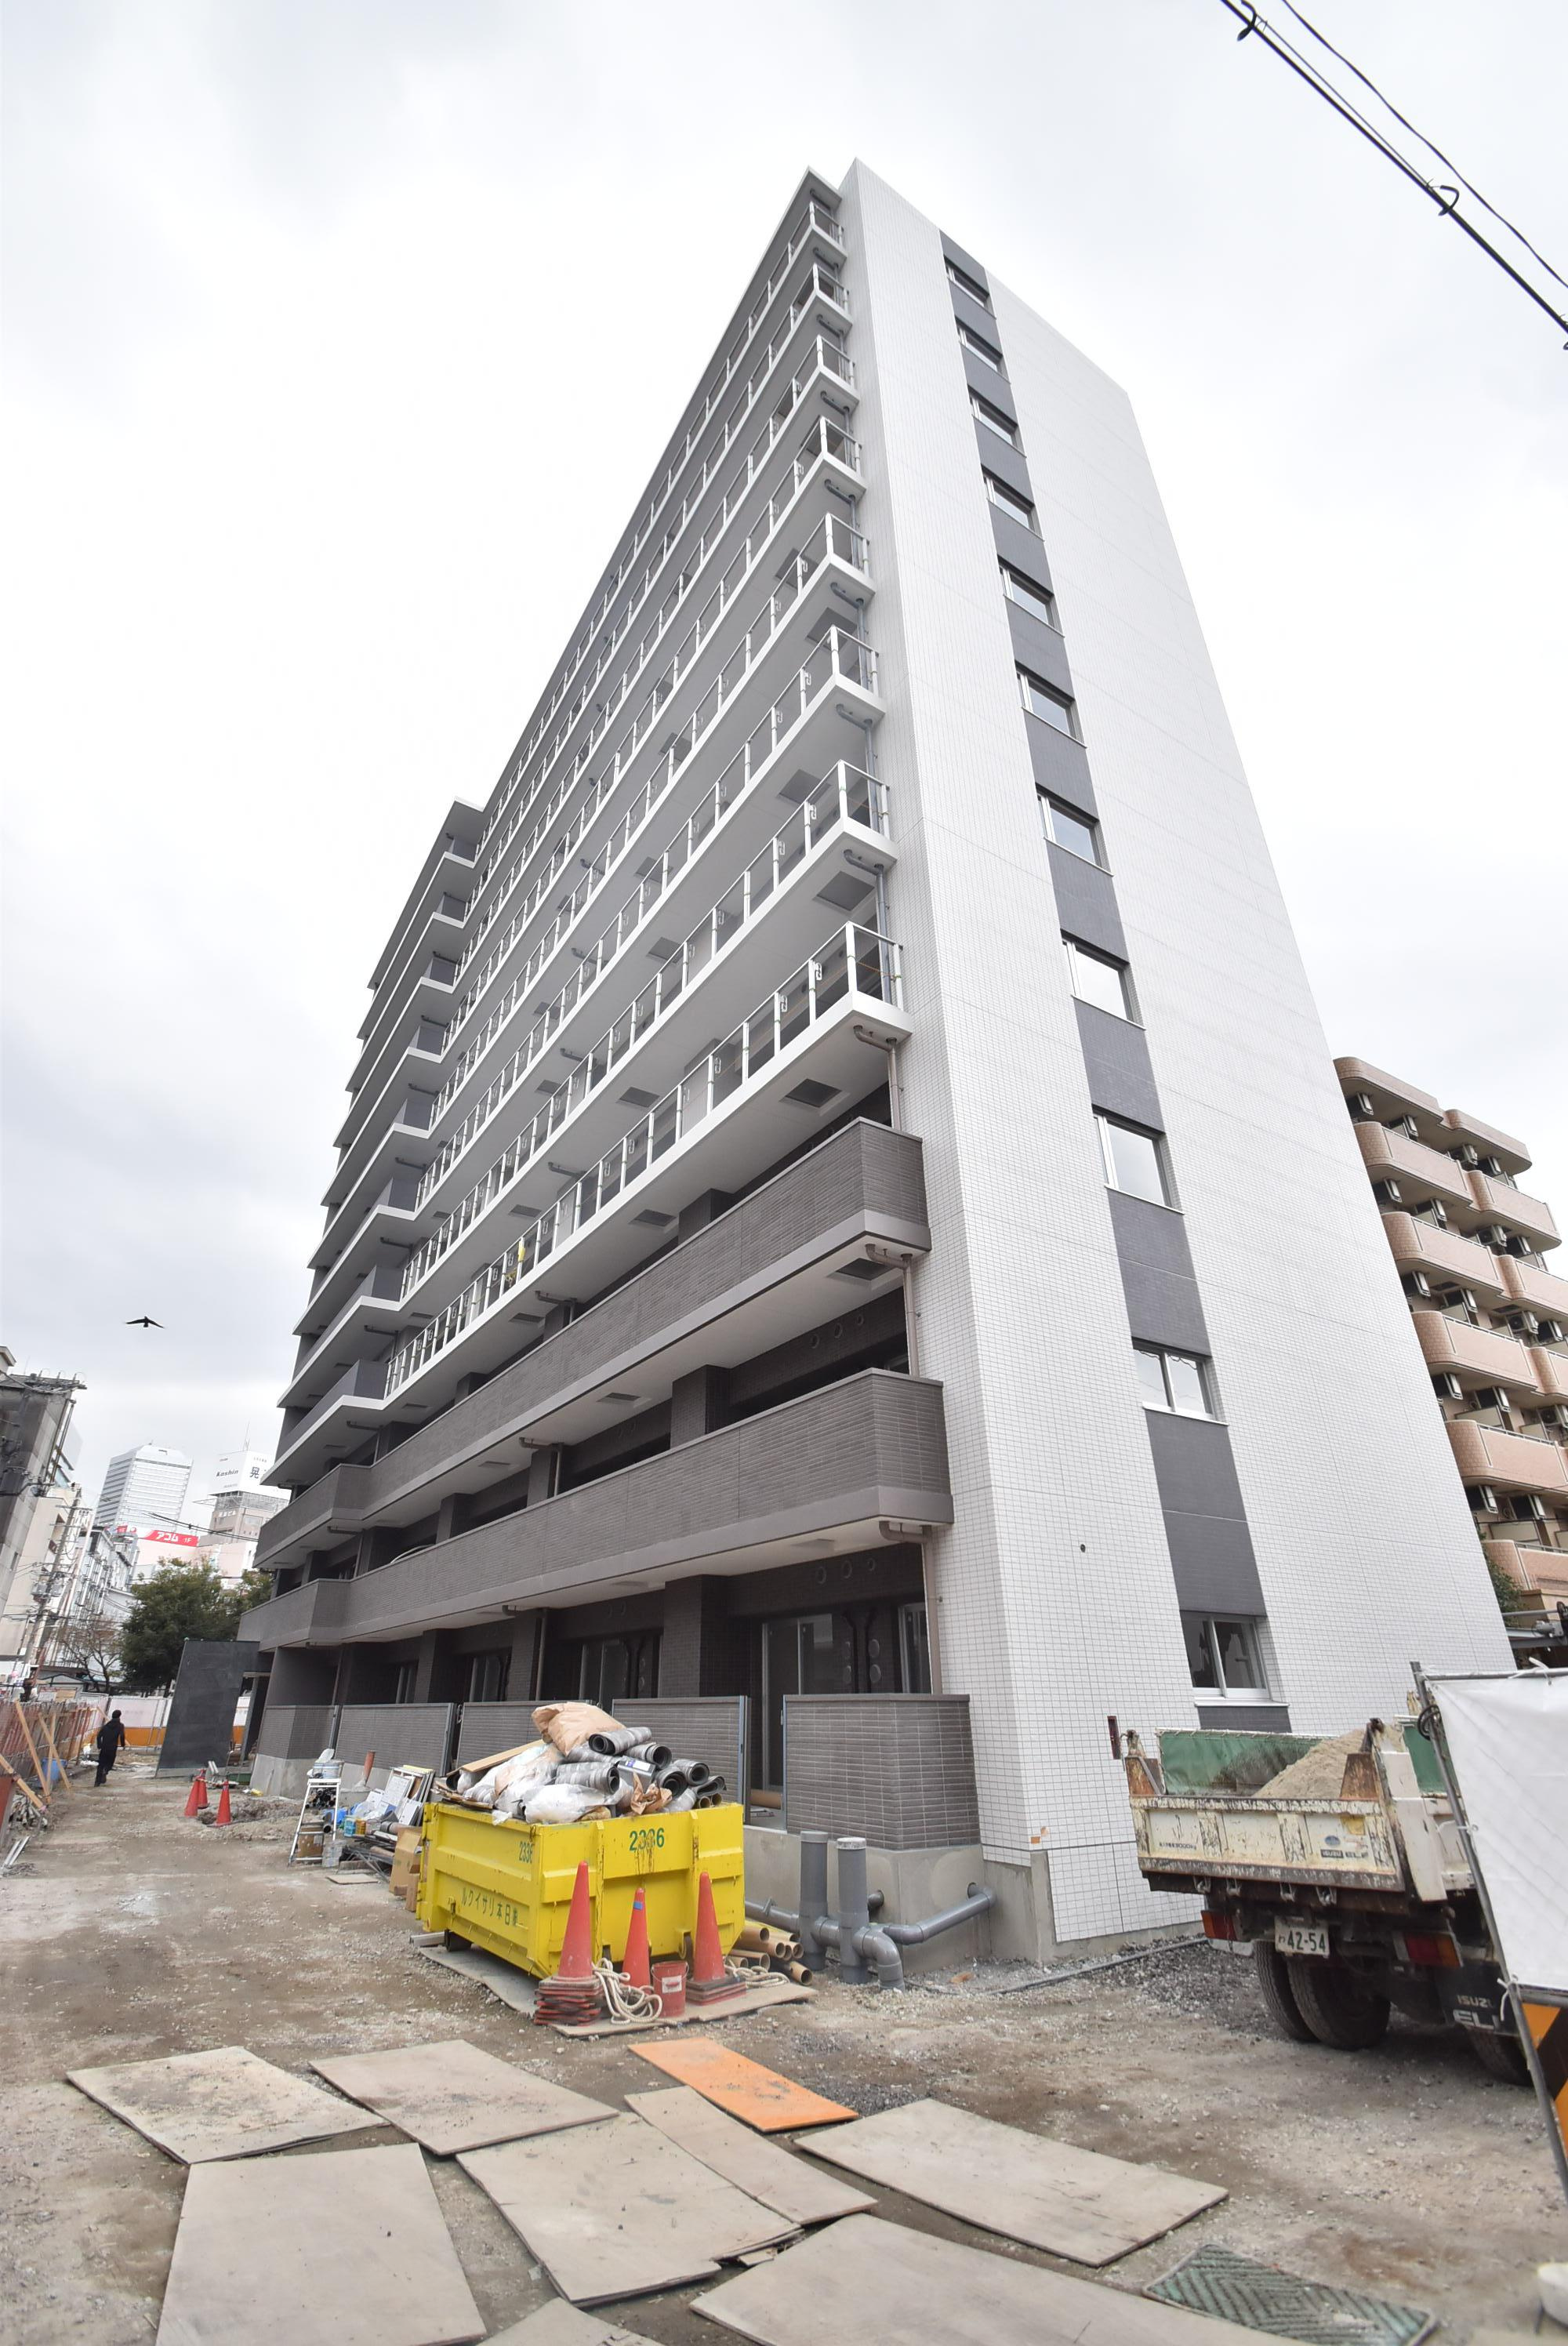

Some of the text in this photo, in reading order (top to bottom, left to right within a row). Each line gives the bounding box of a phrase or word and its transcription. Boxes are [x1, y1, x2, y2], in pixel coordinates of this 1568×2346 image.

[156, 1531, 179, 1542] アコム
[1287, 1930, 1326, 1953] 42-54
